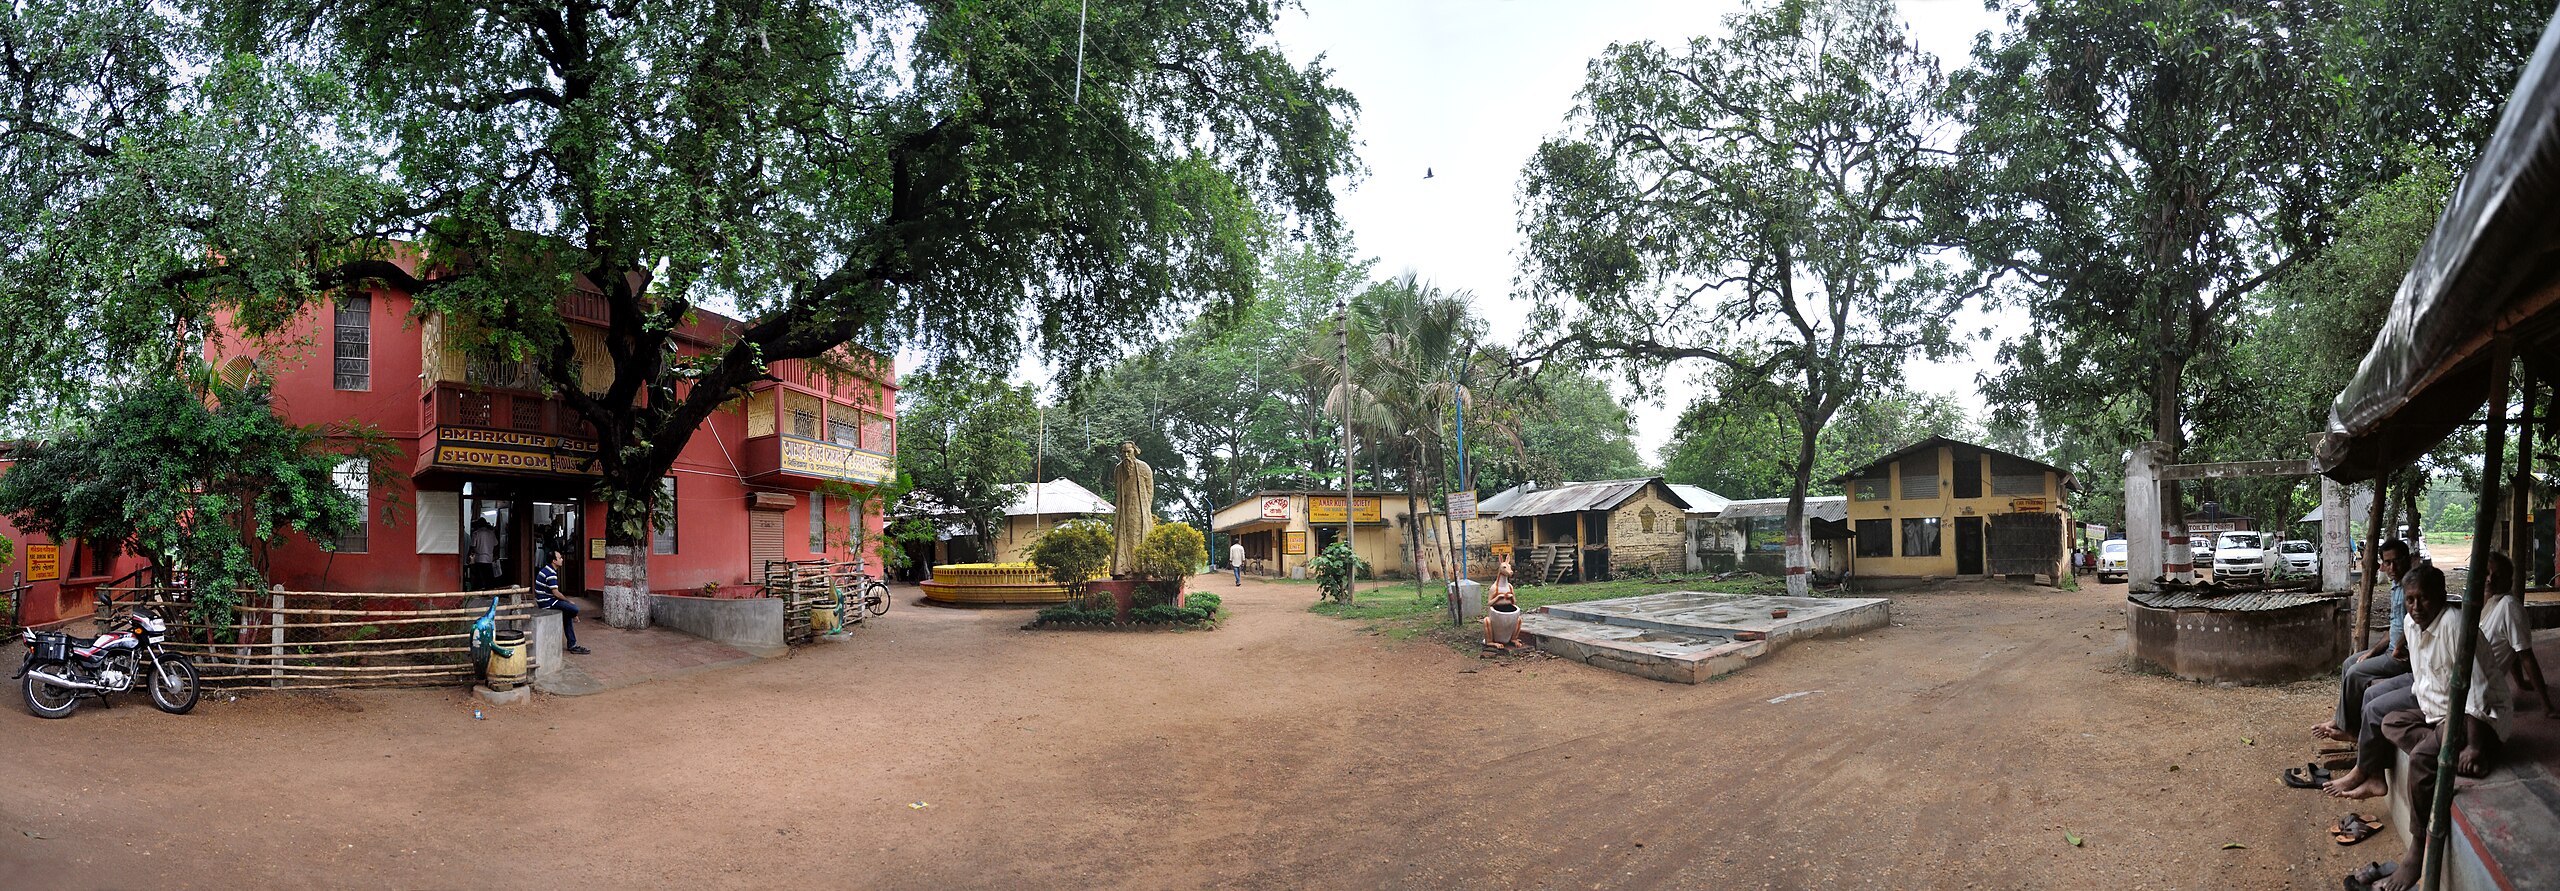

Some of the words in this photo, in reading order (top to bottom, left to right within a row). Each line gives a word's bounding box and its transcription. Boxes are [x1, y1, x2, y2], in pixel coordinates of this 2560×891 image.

[441, 428, 547, 446] AMARKUTIR
[442, 450, 494, 464] SHOW
[499, 453, 549, 468] ROOM
[555, 456, 579, 471] HOUS
[1319, 499, 1333, 507] AMAR
[1334, 499, 1348, 507] KUTI
